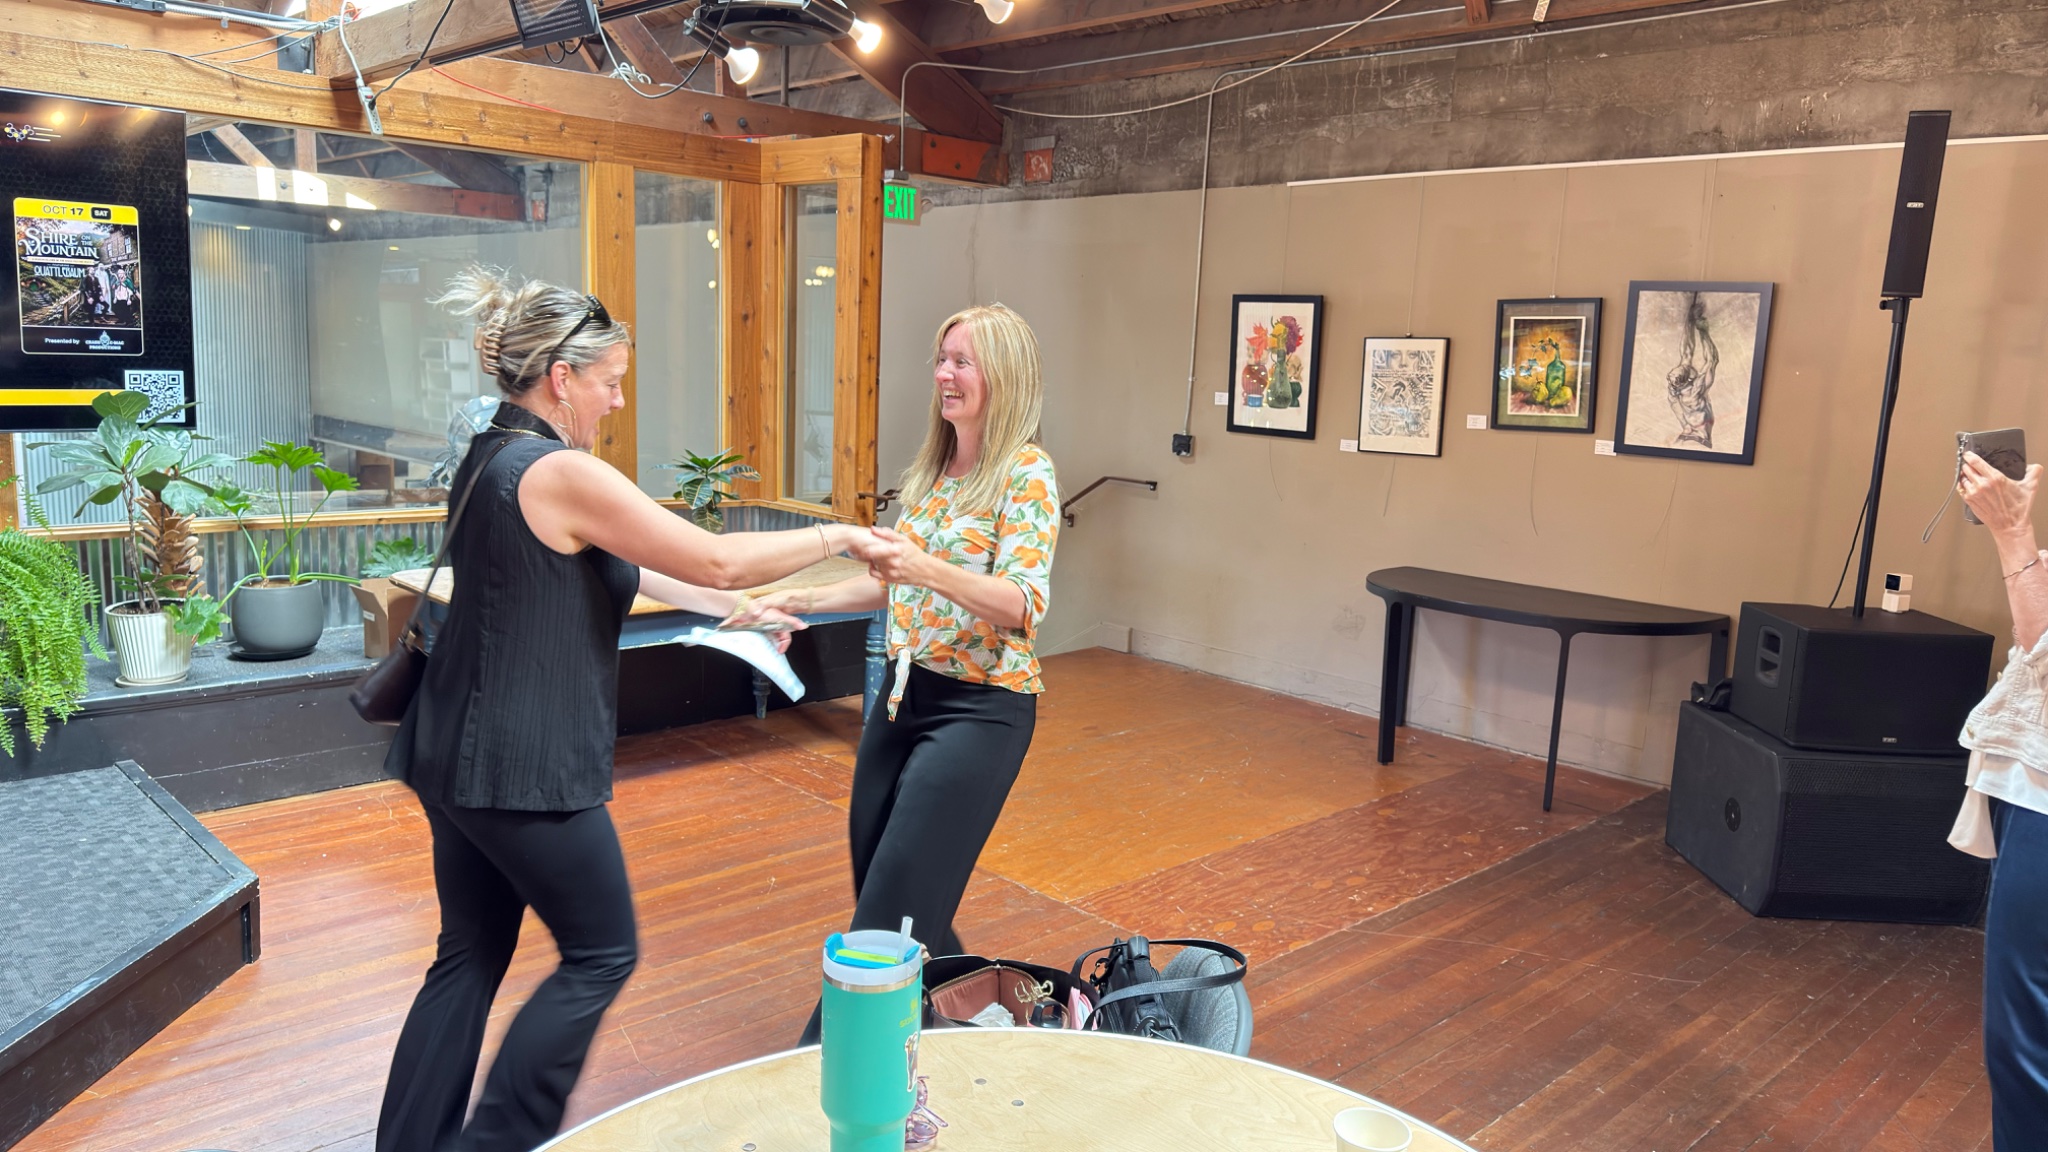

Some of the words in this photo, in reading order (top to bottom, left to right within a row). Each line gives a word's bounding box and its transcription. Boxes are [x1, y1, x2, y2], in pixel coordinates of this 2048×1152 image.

[43, 204, 67, 215] OCT
[70, 207, 84, 216] 17
[94, 209, 109, 217] SAT
[884, 185, 917, 220] EXIT
[25, 227, 78, 246] SHIRE
[18, 238, 100, 259] MOUNTAIN
